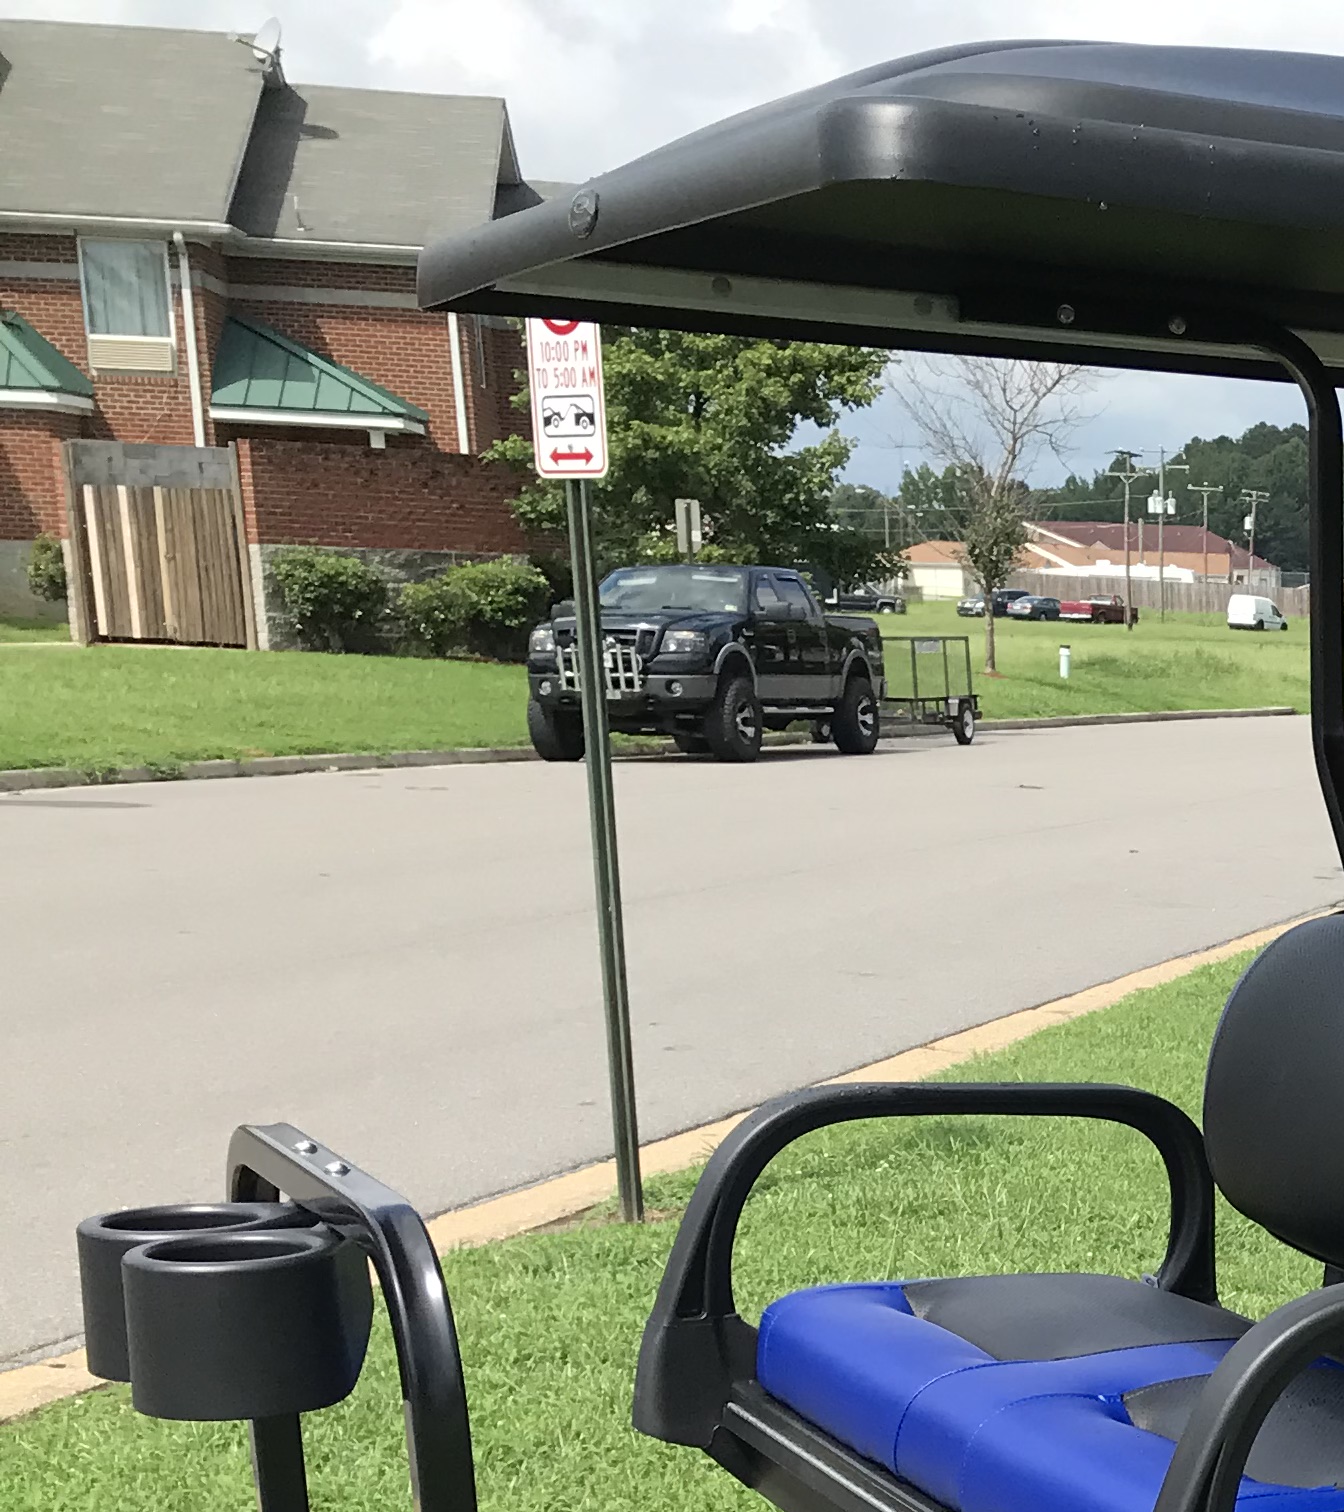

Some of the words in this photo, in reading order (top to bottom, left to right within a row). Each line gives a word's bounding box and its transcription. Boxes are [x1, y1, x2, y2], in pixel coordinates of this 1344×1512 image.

[540, 340, 569, 363] 10:00
[574, 340, 588, 361] PM
[536, 367, 548, 389] TO
[553, 366, 577, 389] 5:00
[581, 366, 596, 388] AM
